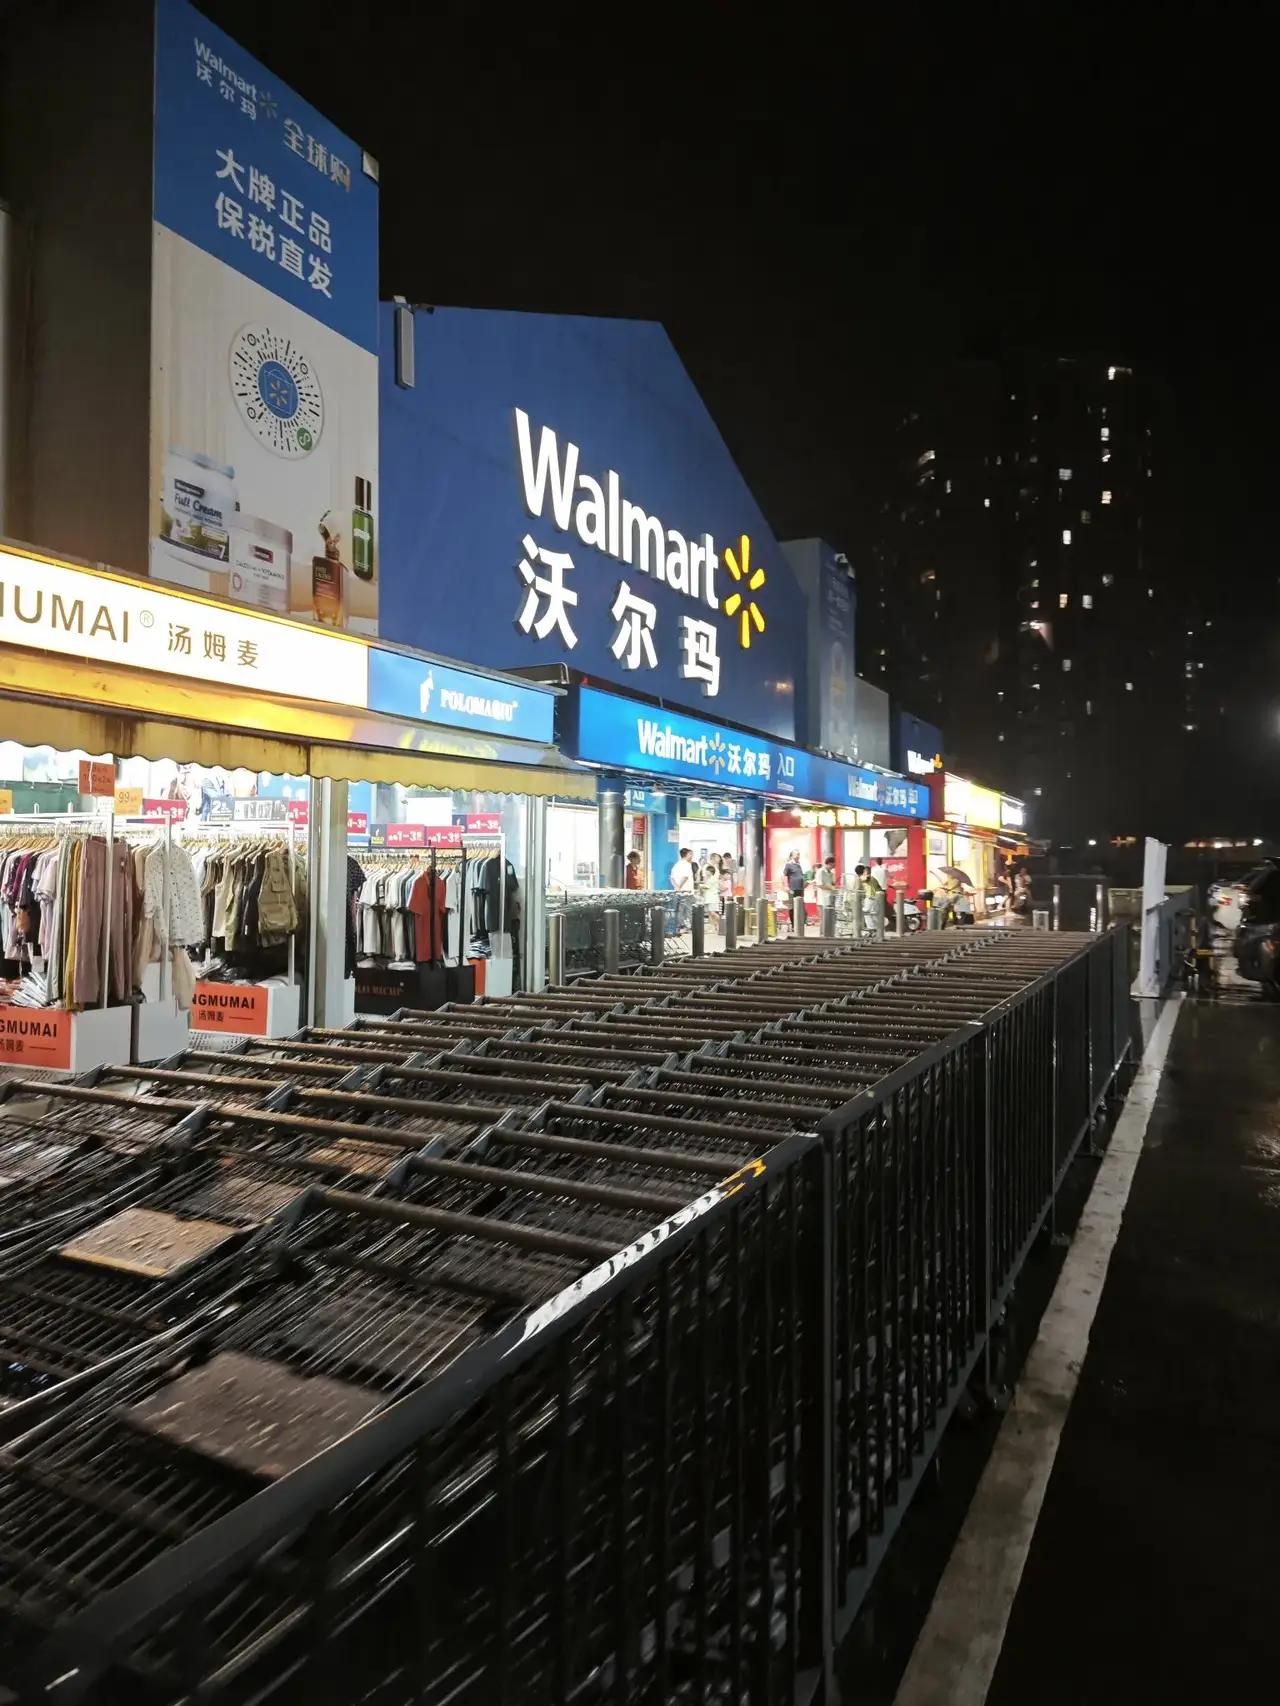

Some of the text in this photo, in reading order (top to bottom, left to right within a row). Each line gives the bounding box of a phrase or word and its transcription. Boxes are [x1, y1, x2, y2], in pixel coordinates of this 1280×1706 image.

[194, 37, 257, 101] Walmart
[196, 60, 257, 120] 沃尔玛
[283, 118, 350, 192] 全球购
[215, 149, 332, 254] 大牌正品
[215, 191, 333, 299] 保税直发
[514, 407, 719, 610] Walmart
[0, 580, 129, 643] UMAI
[167, 622, 259, 670] 汤姆麦
[516, 533, 721, 697] 沃尔玛
[637, 718, 795, 781] Walmart 沃尔玛 入口
